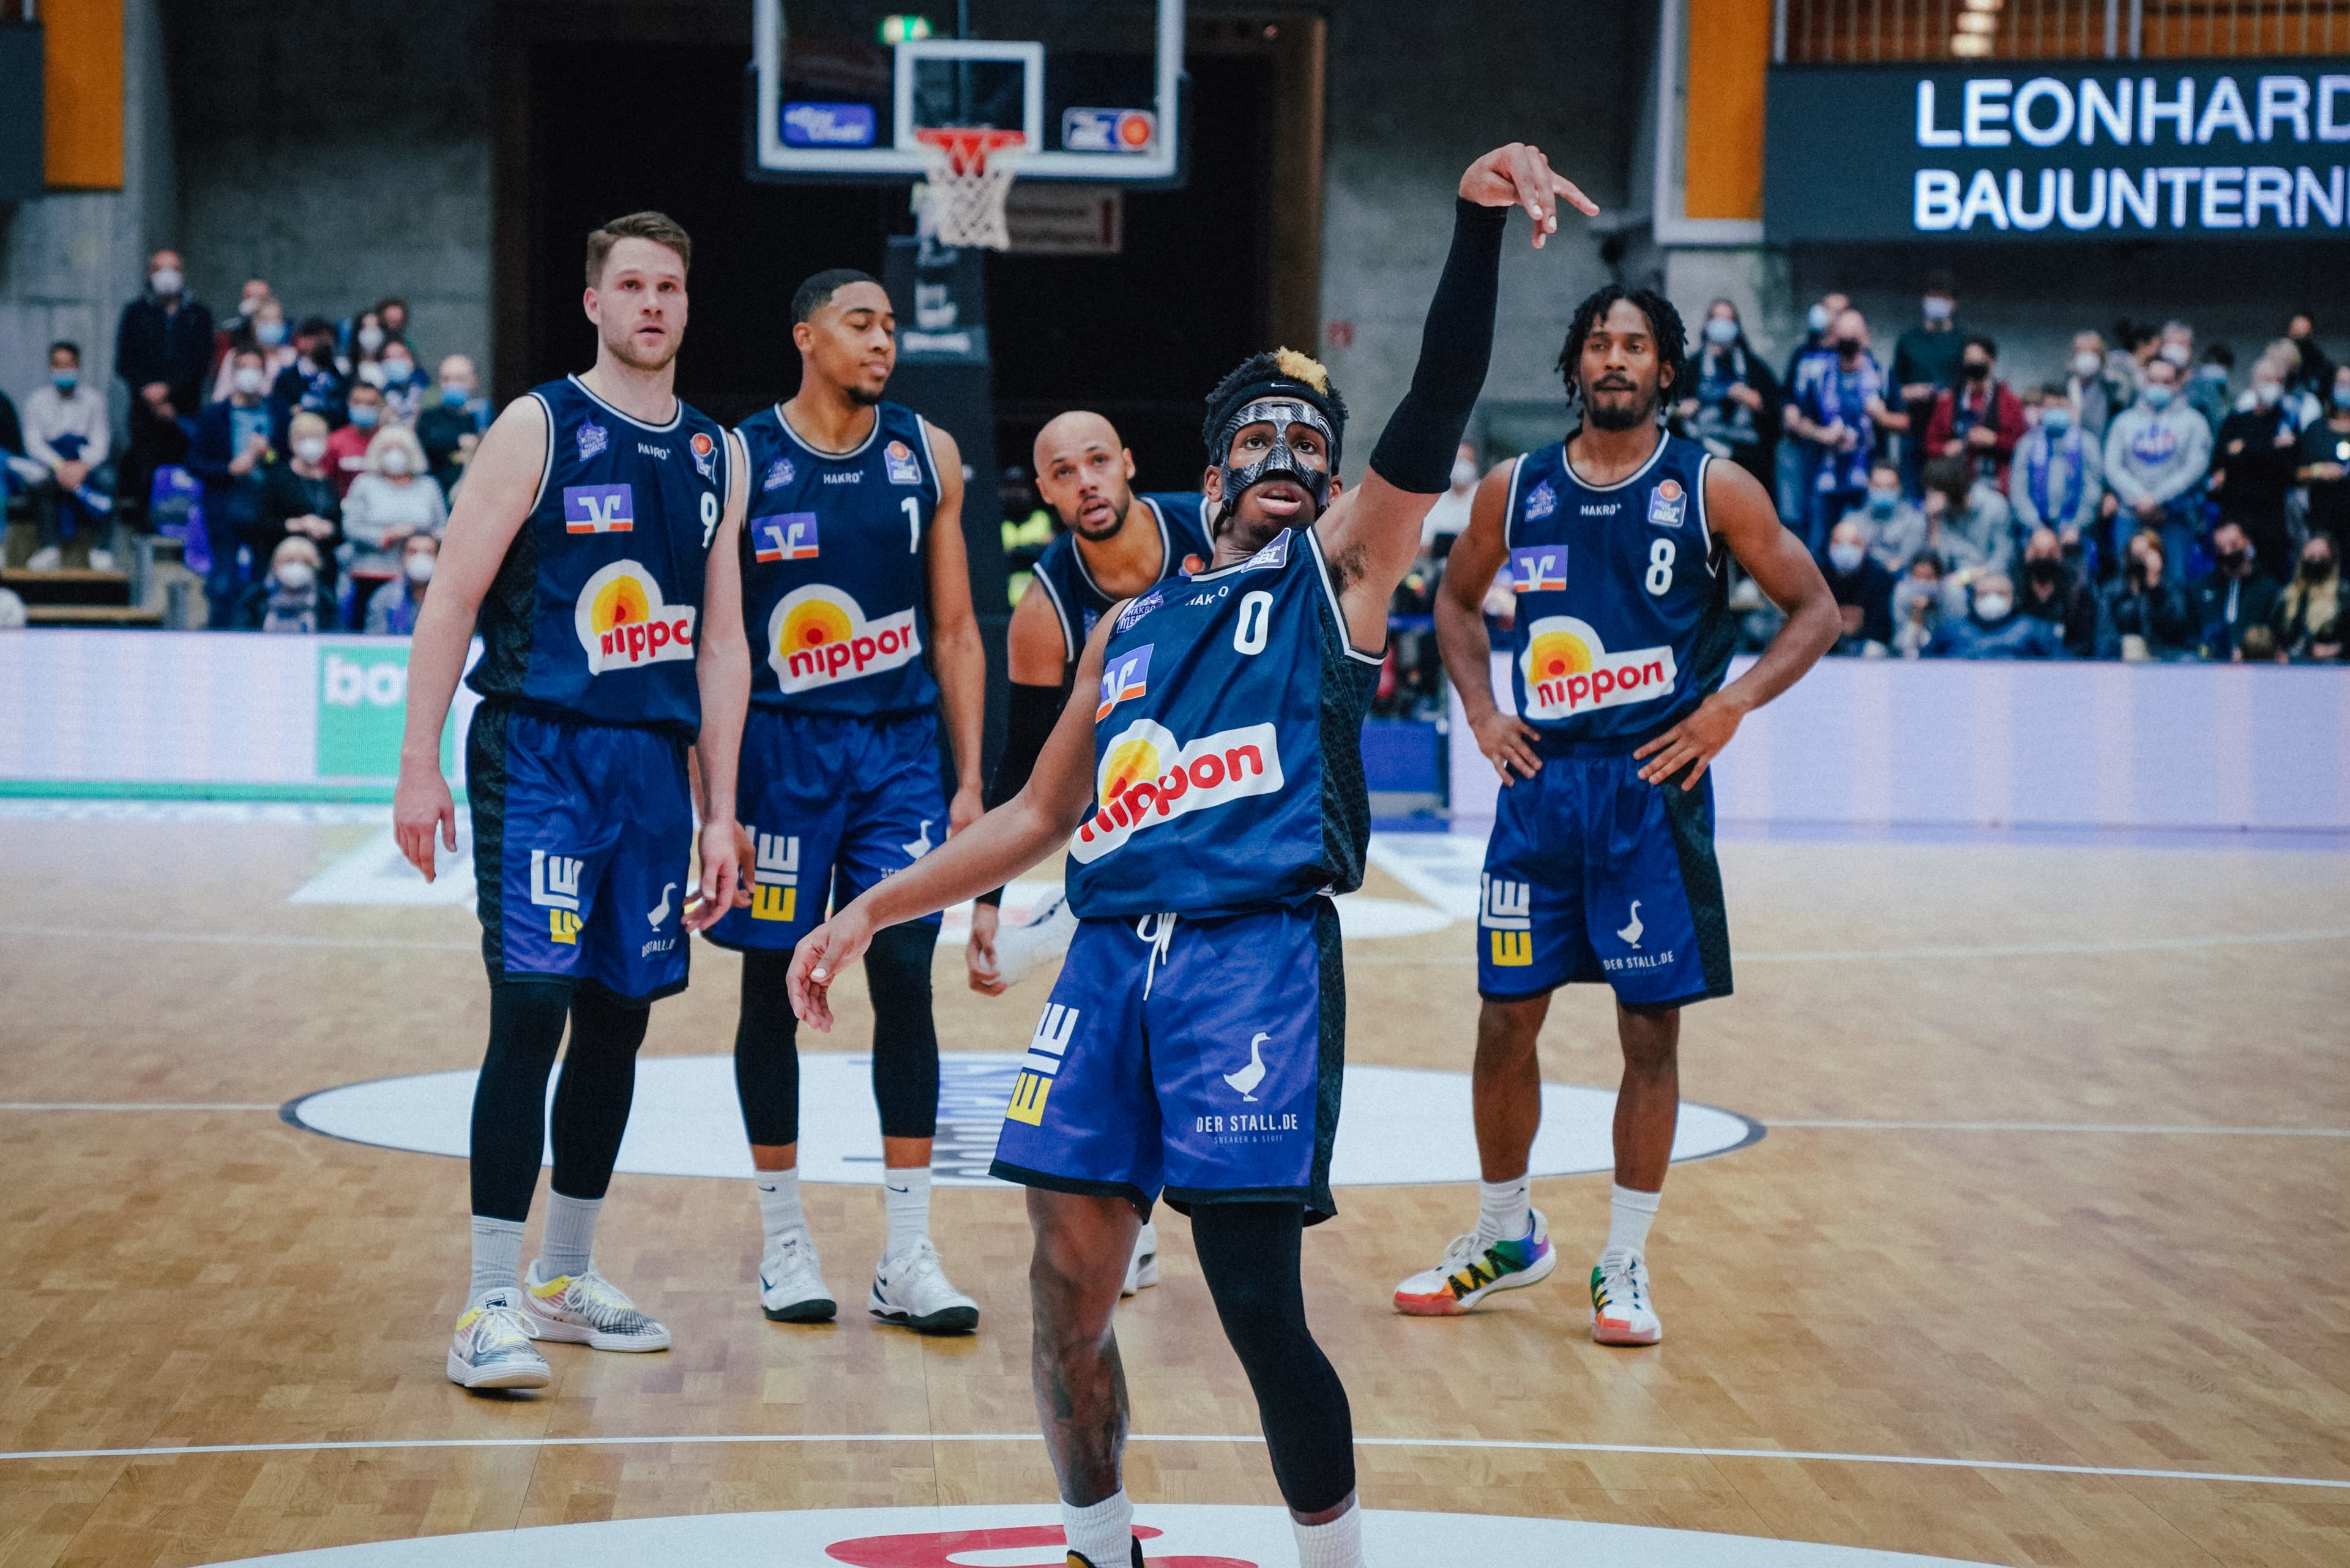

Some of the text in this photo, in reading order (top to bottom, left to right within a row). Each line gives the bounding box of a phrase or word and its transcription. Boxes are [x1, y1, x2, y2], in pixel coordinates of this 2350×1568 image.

[1913, 165, 2350, 231] BAUUNTERN
[823, 472, 860, 484] HAKRO
[700, 491, 718, 548] 9
[901, 496, 919, 554] 1
[1581, 504, 1616, 516] HAKRO
[1646, 537, 1676, 596] 8
[1185, 586, 1229, 607] AKO
[600, 619, 692, 662] nippo
[1233, 590, 1274, 655] 0
[1537, 661, 1665, 709] nippon
[1080, 744, 1264, 843] nippon
[1603, 958, 1624, 970] DER
[1196, 1113, 1298, 1133] DER STALL.DE
